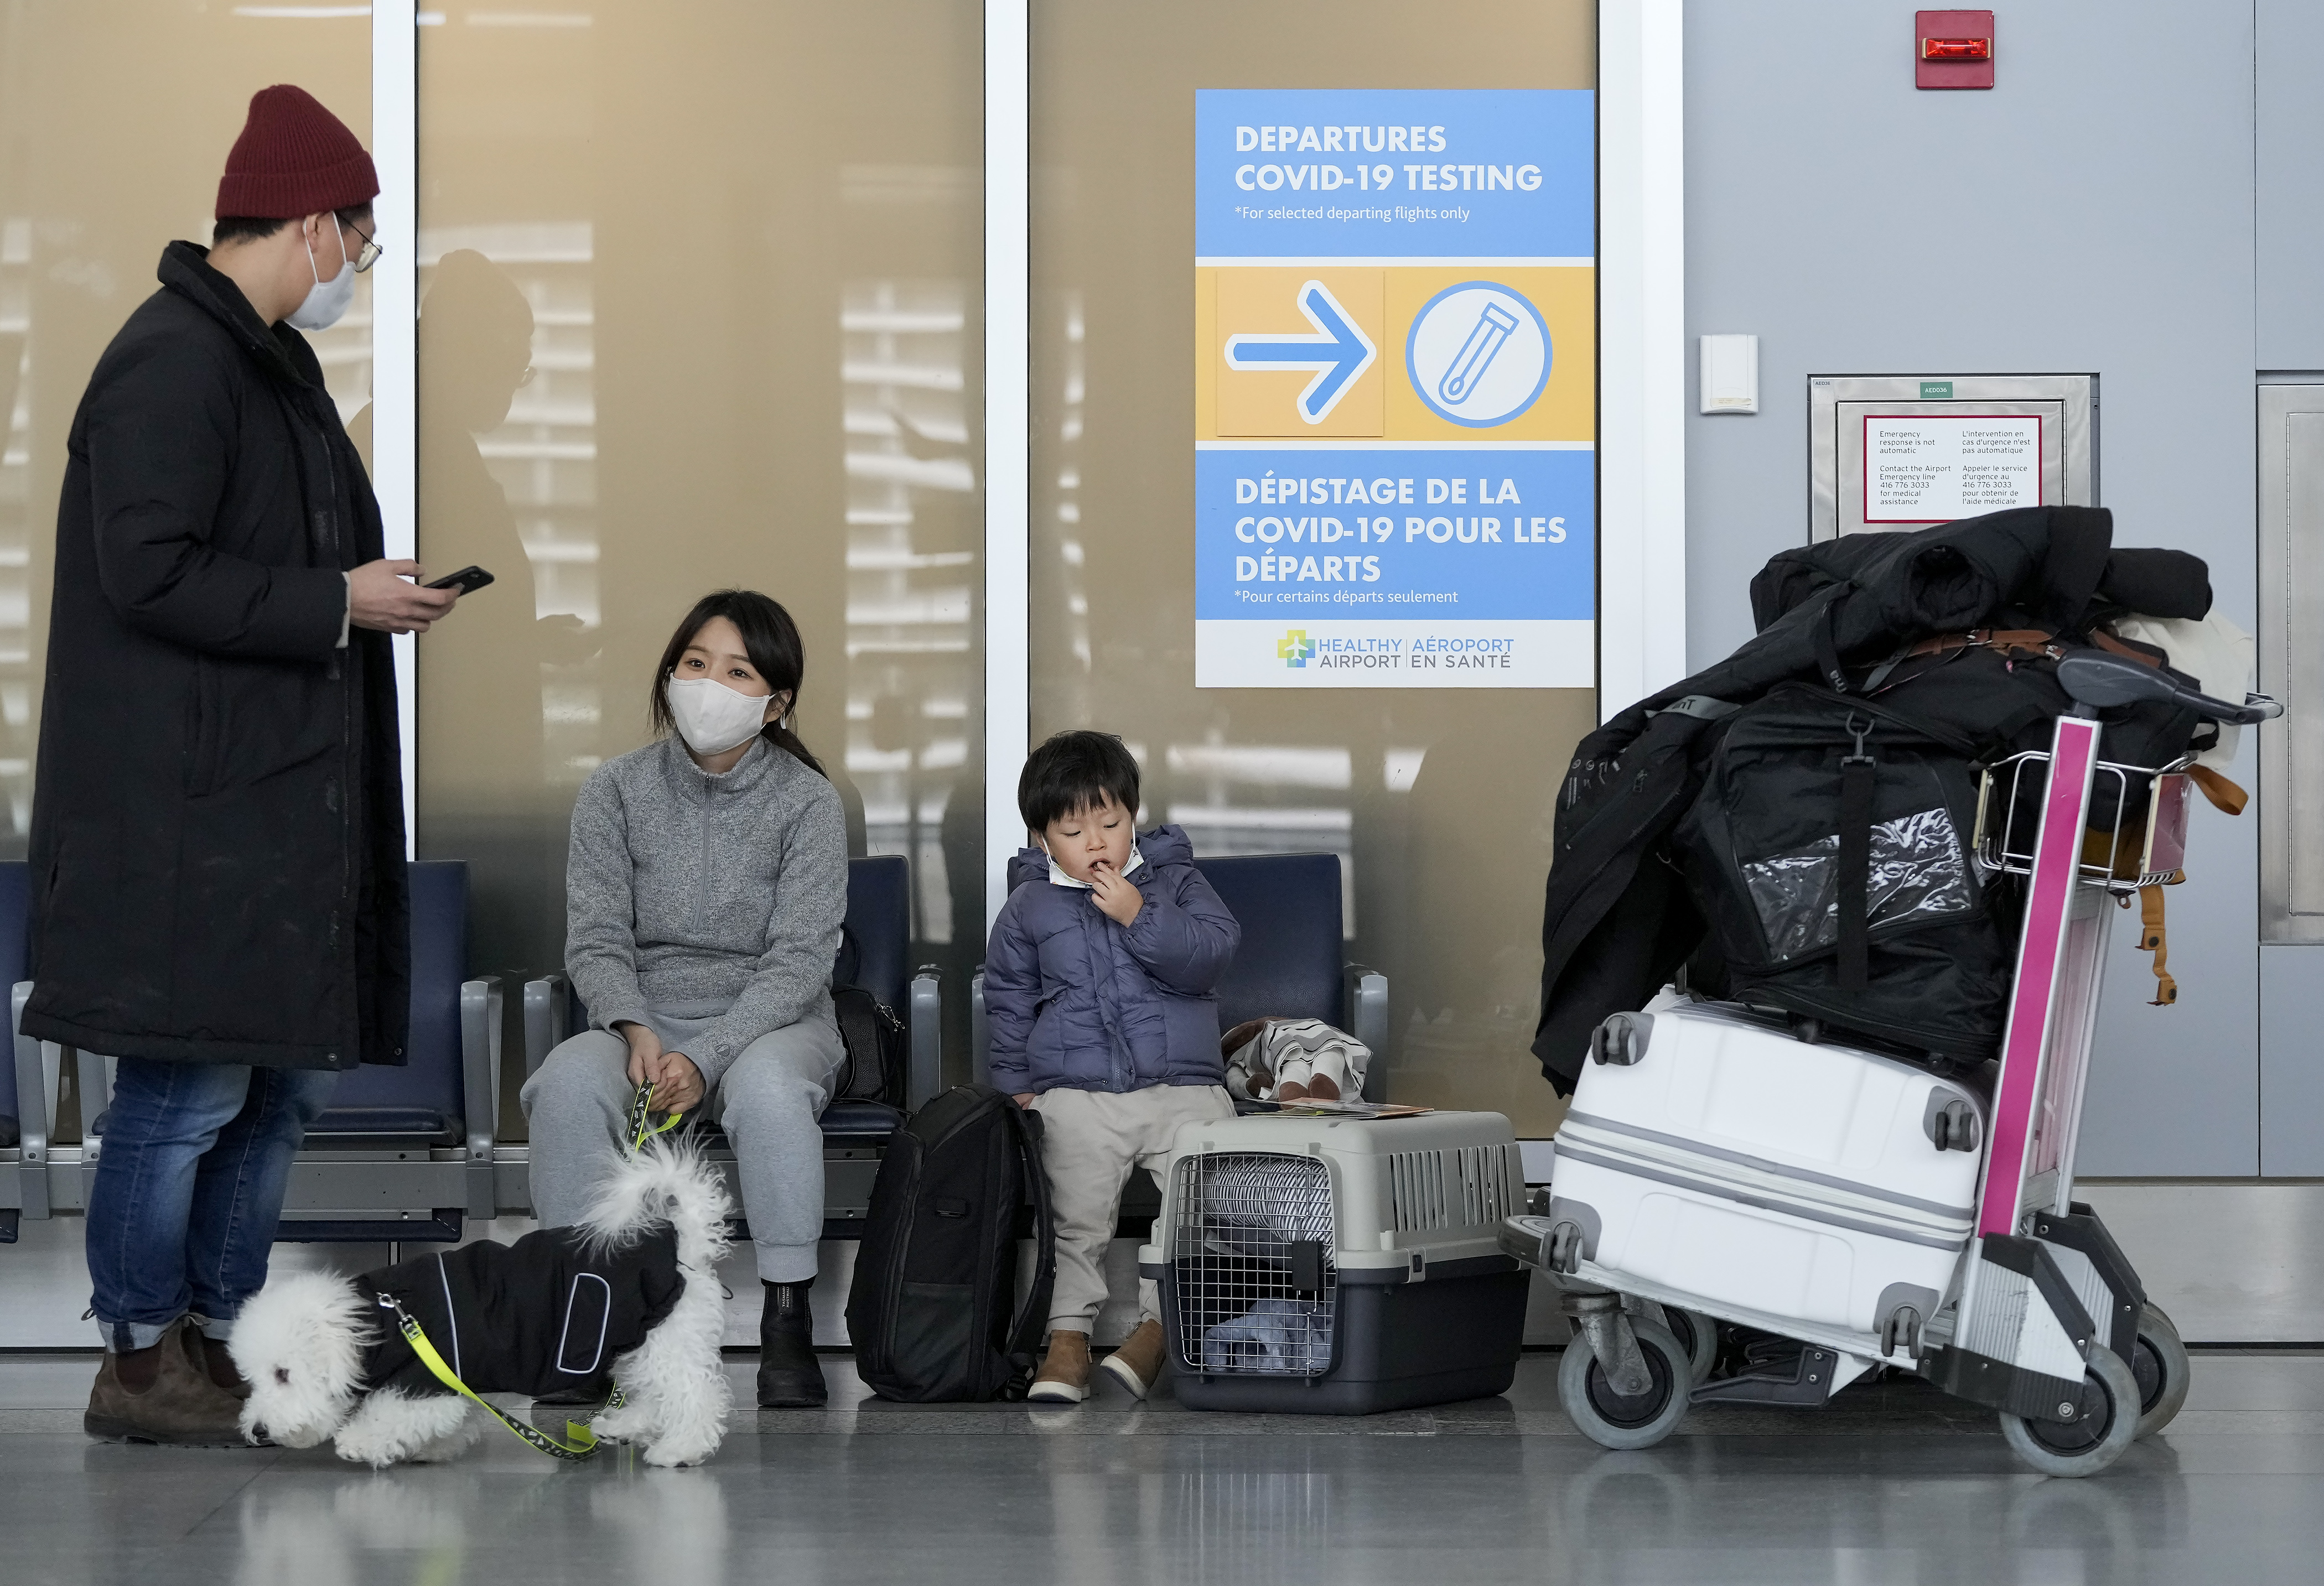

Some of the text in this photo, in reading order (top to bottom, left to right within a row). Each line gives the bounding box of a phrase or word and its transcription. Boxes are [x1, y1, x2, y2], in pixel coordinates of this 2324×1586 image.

[1237, 126, 1446, 152] DEPARTURES
[1236, 164, 1542, 191] COVID-19 TESTING
[1268, 206, 1322, 219] selected
[1327, 206, 1391, 223] departing
[1395, 206, 1436, 223] flights
[1441, 206, 1470, 222] only
[1880, 430, 1921, 439] Emergency
[1977, 446, 2024, 455] automatique
[1924, 465, 1951, 473] Airport
[1962, 473, 1999, 481] d'urgence
[1236, 469, 1521, 505] DÉPISTAGE DE LA
[1236, 516, 1566, 544] COVID-19 POUR LES
[1236, 547, 1381, 583] DÉPARTS
[1277, 590, 1329, 602] certains
[1333, 589, 1384, 606] départs
[1388, 590, 1458, 603] seulement
[1320, 639, 1402, 652] HEALTHY
[1412, 636, 1514, 652] AÉROPORT
[1320, 655, 1400, 668] AIRPORT
[1412, 650, 1510, 668] EN SANTÉ
